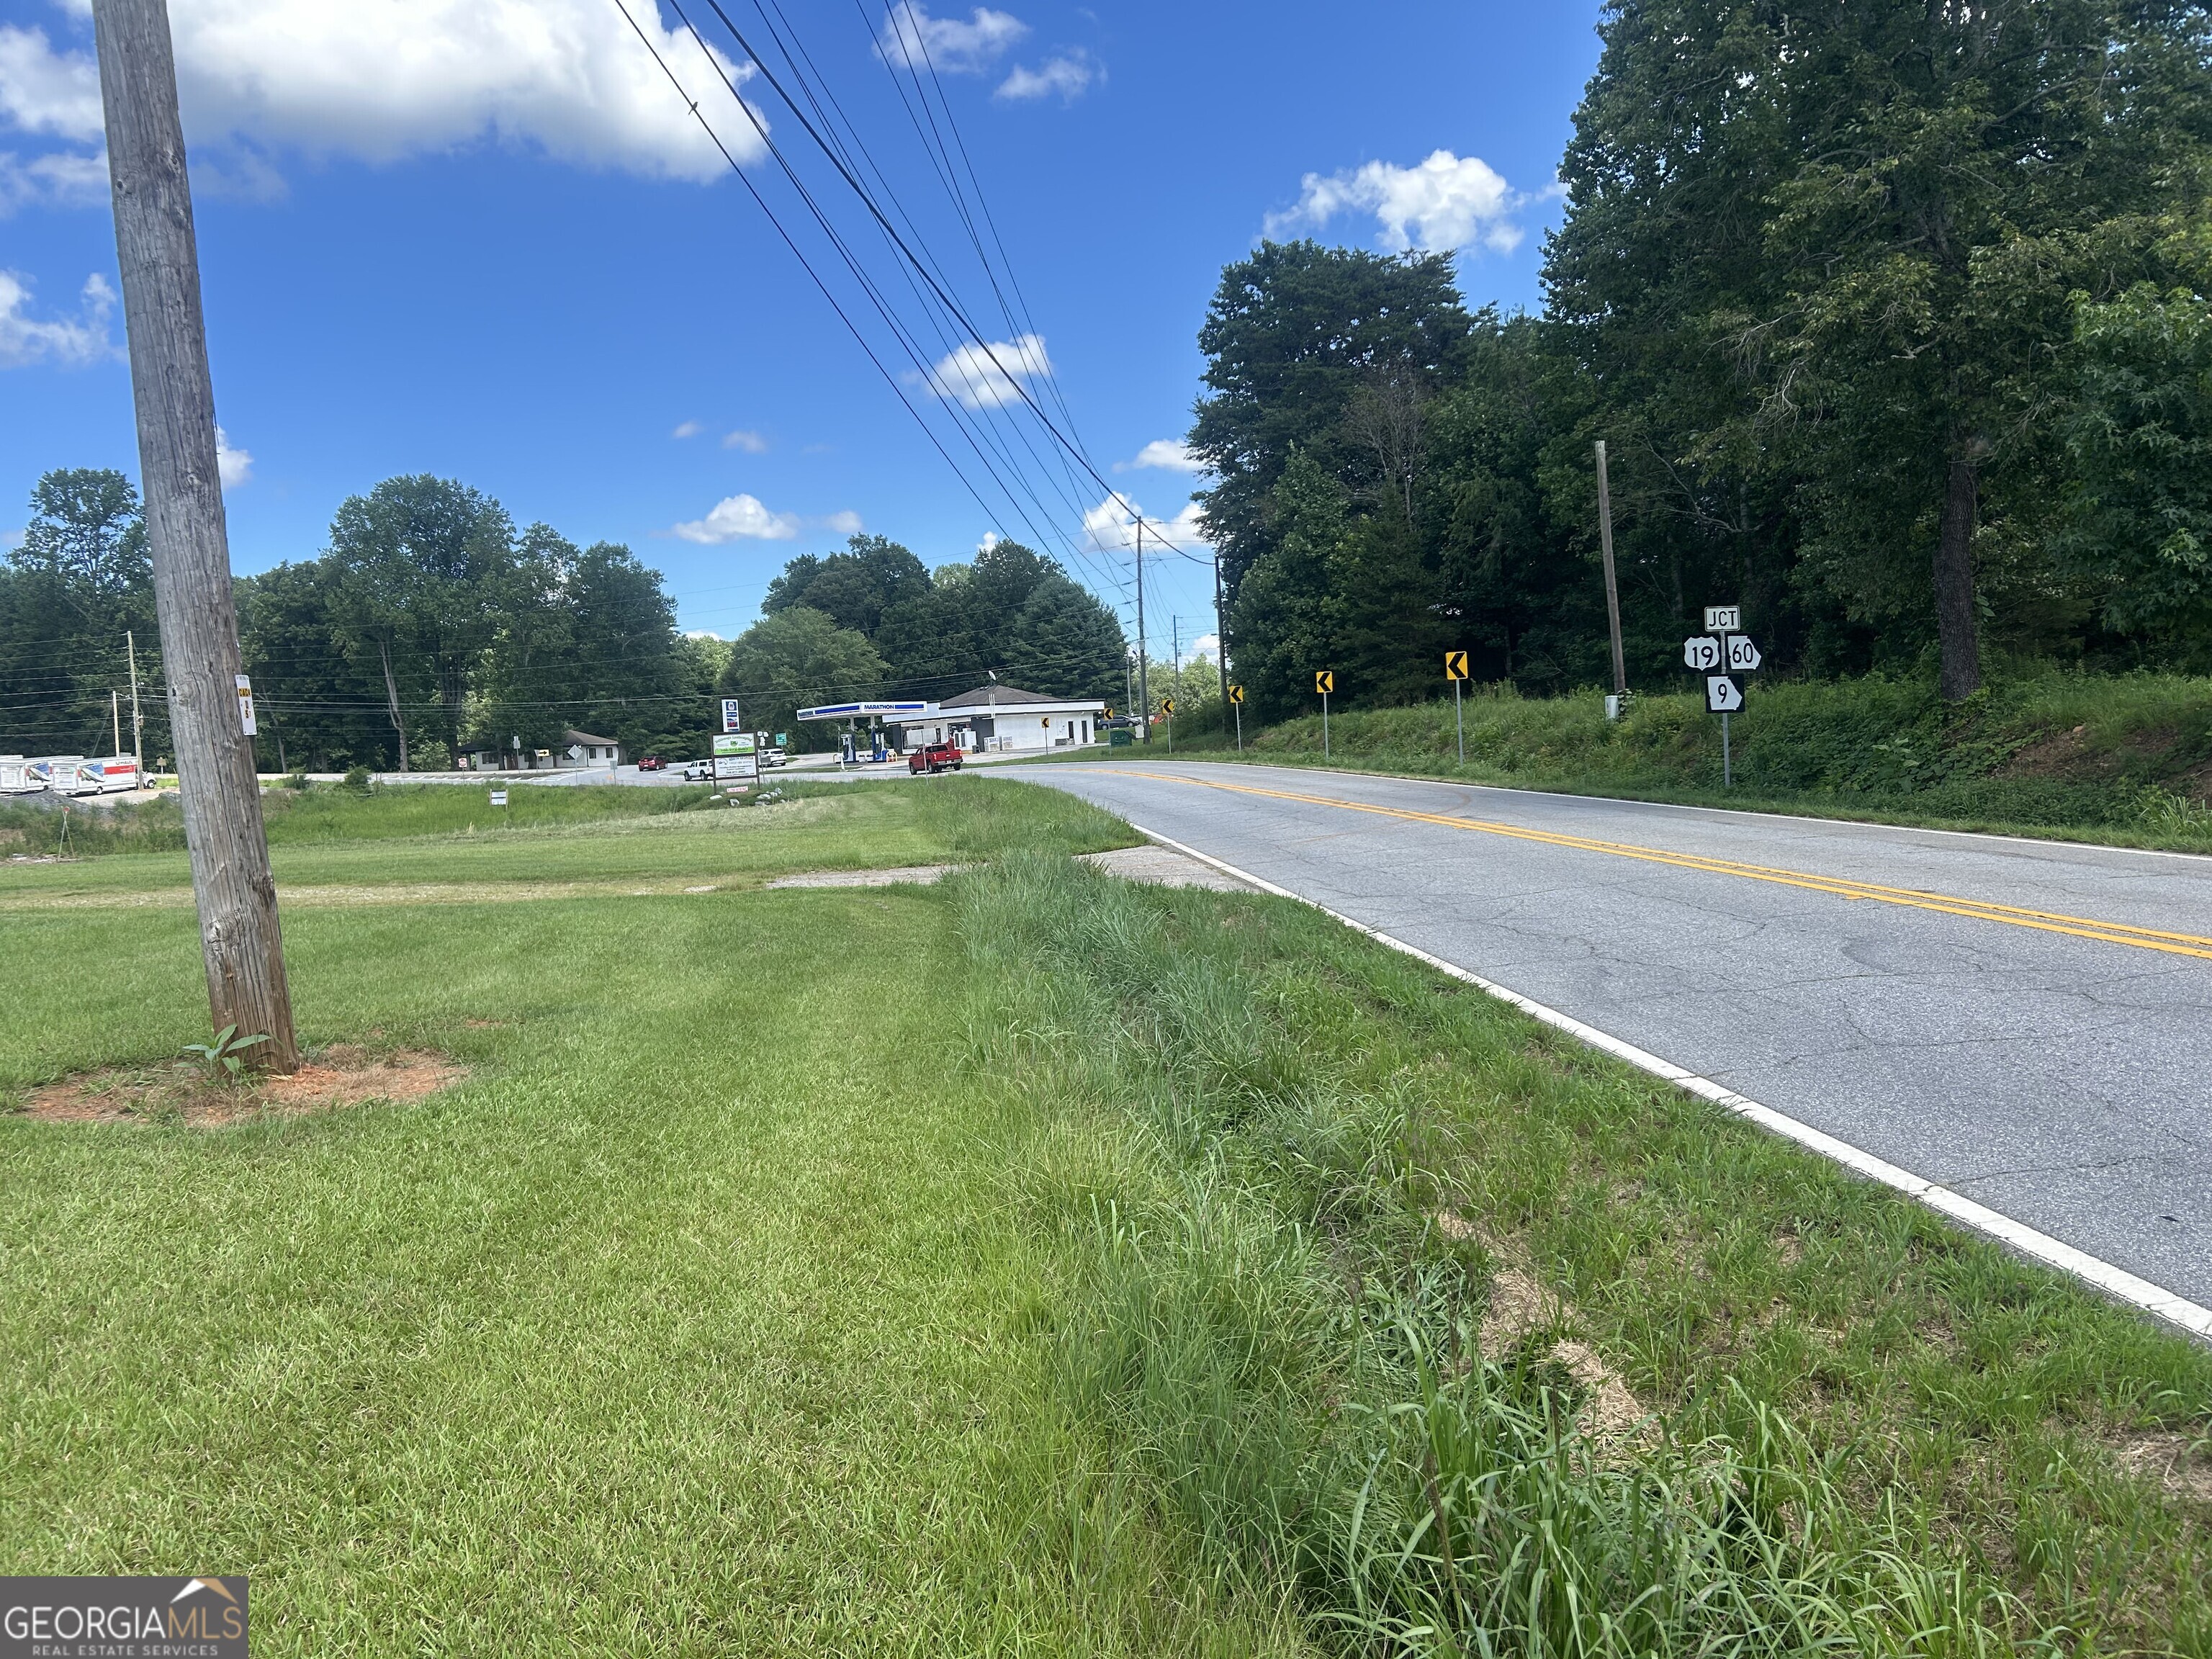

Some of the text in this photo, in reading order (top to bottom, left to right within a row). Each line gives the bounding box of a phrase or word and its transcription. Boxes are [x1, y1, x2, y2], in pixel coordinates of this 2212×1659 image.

[1709, 611, 1737, 626] JCT
[1692, 646, 1714, 667] 19
[1732, 642, 1753, 663] 60
[1718, 683, 1727, 703] 9
